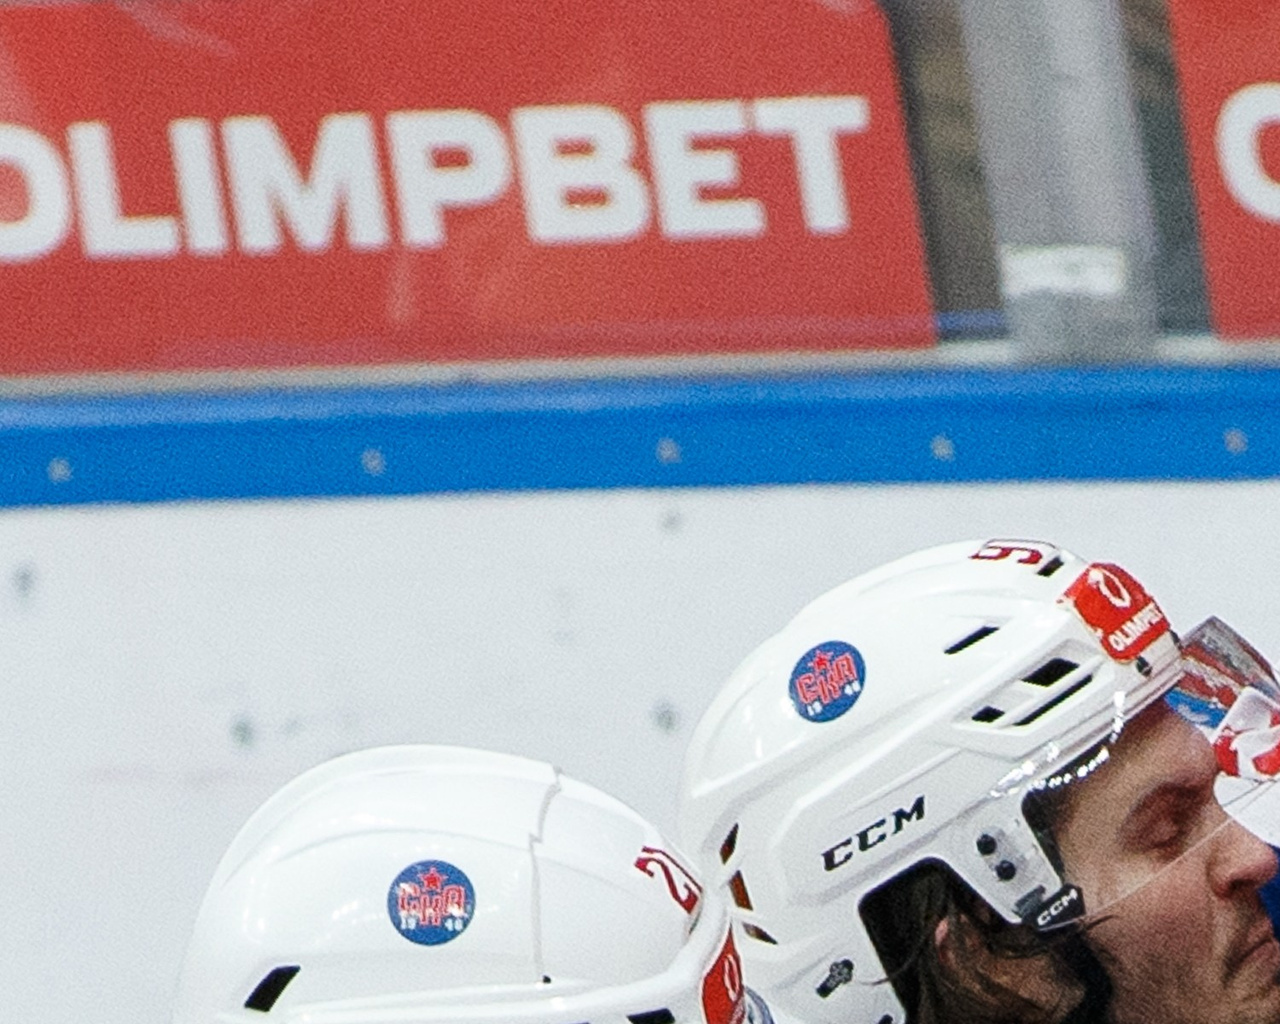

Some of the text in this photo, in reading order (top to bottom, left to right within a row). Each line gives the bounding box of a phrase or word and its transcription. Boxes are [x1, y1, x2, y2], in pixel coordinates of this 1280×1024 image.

[0, 95, 870, 264] OLIMPBET
[821, 795, 925, 872] CCM
[1036, 888, 1079, 926] CCM
